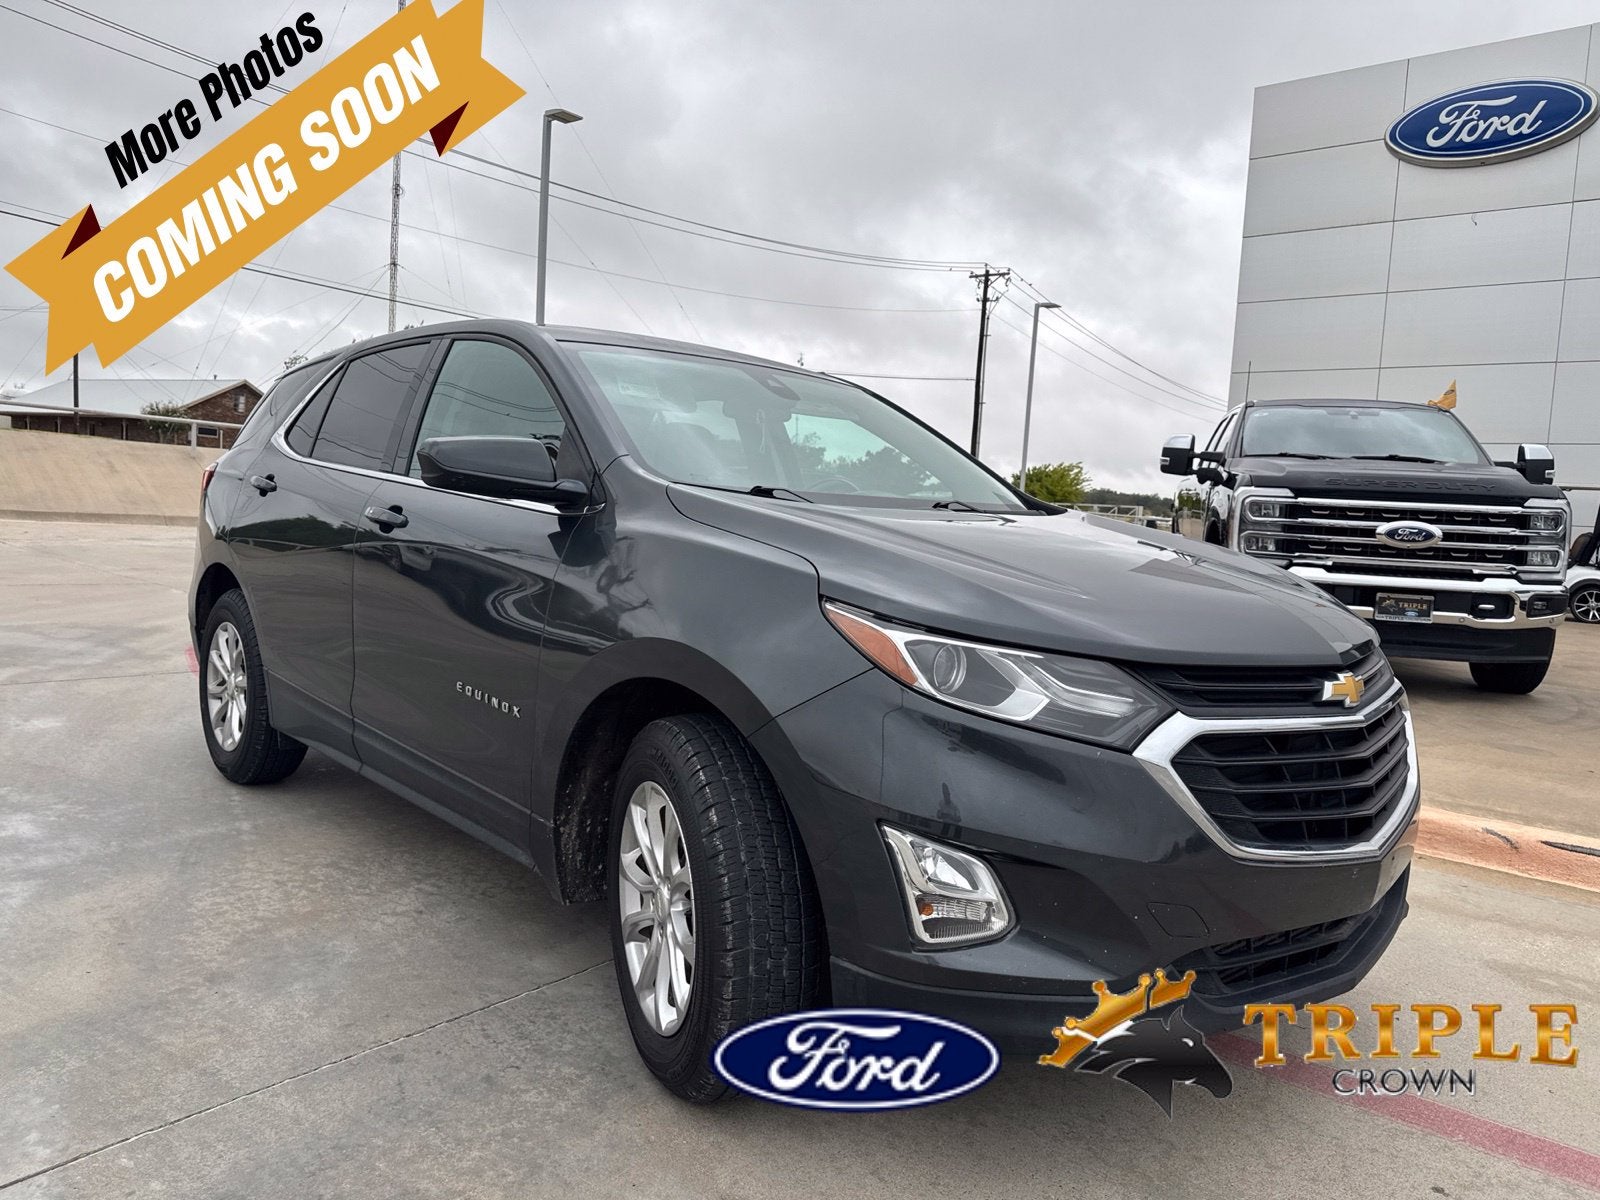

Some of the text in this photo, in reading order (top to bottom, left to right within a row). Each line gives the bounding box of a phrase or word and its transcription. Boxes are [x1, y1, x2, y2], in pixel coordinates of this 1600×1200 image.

[1426, 95, 1548, 148] Ford
[1325, 478, 1497, 492] SUPER DUTY
[1394, 528, 1426, 541] Ford
[1398, 601, 1428, 610] TRIPLE
[456, 681, 521, 719] EQUINOX
